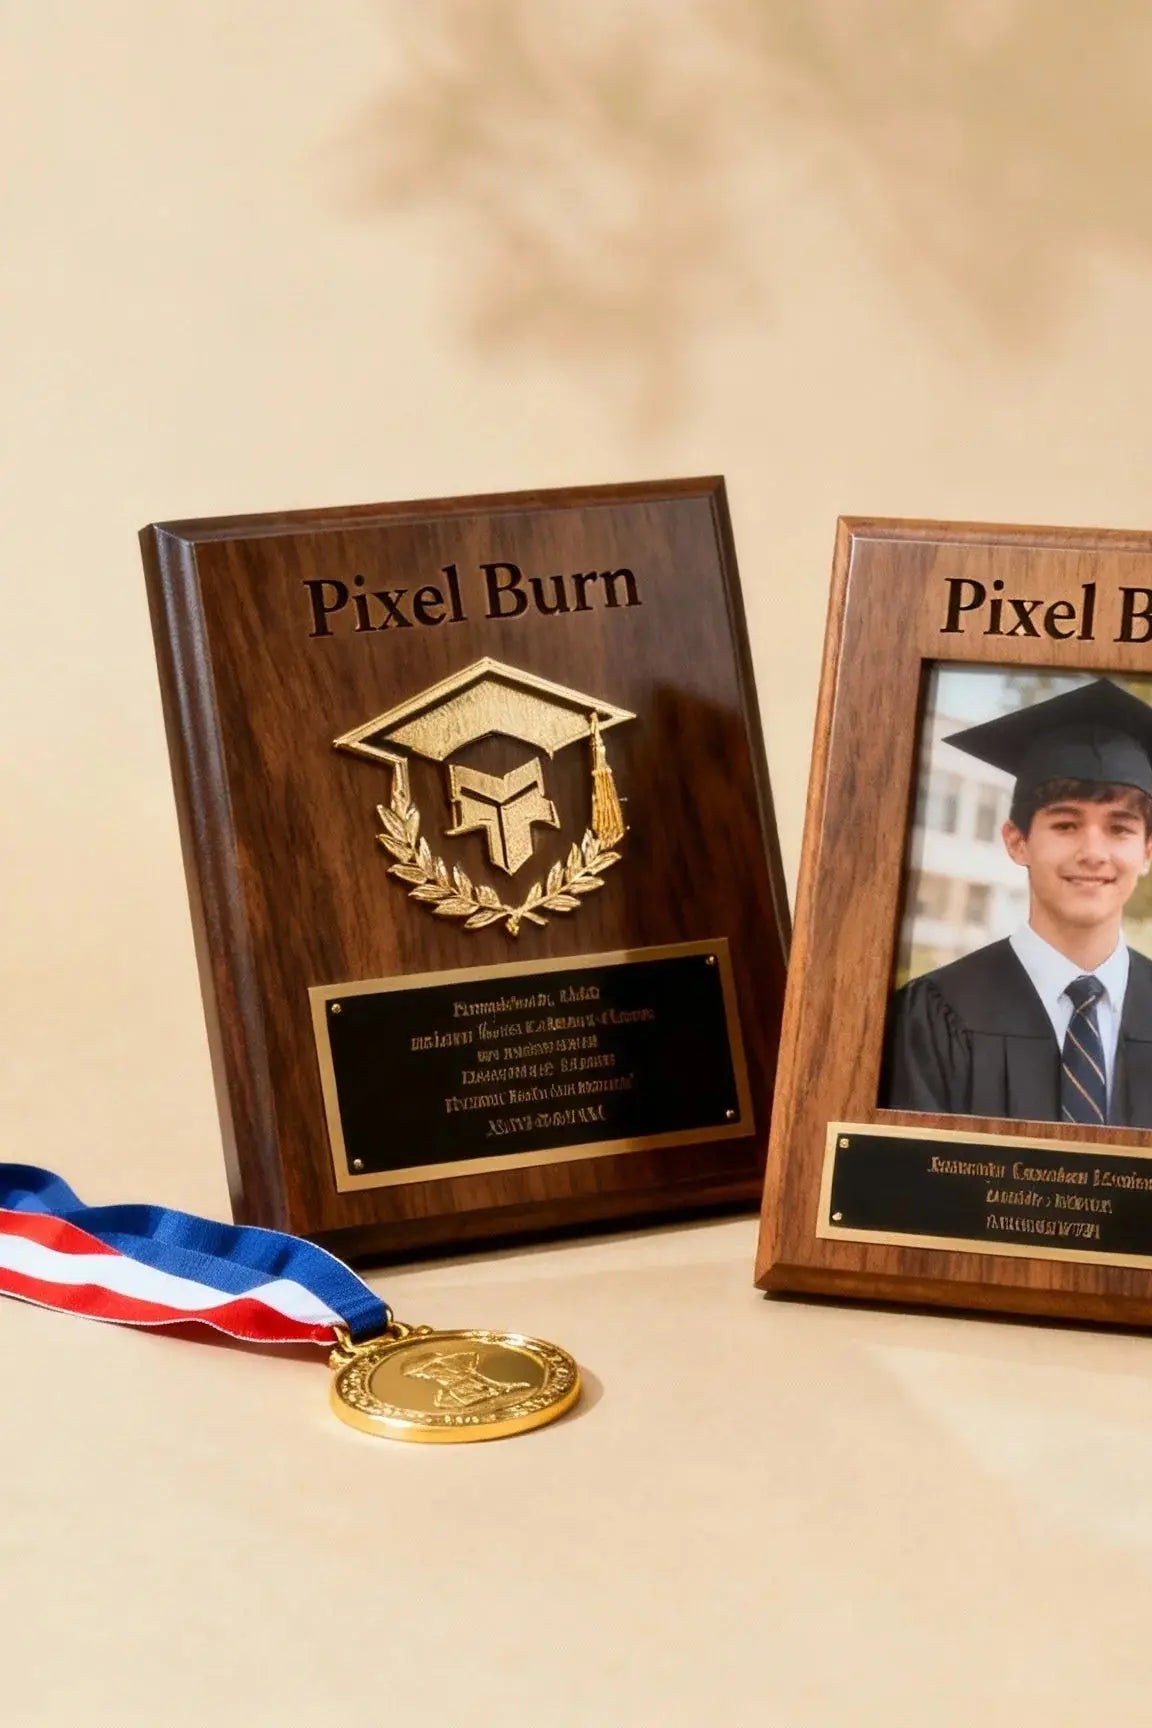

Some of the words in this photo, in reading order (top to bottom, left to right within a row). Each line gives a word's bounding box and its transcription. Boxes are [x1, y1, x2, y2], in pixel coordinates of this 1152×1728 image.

[303, 564, 467, 637] Pixel
[479, 562, 642, 619] Burn
[940, 577, 1096, 641] Pixel
